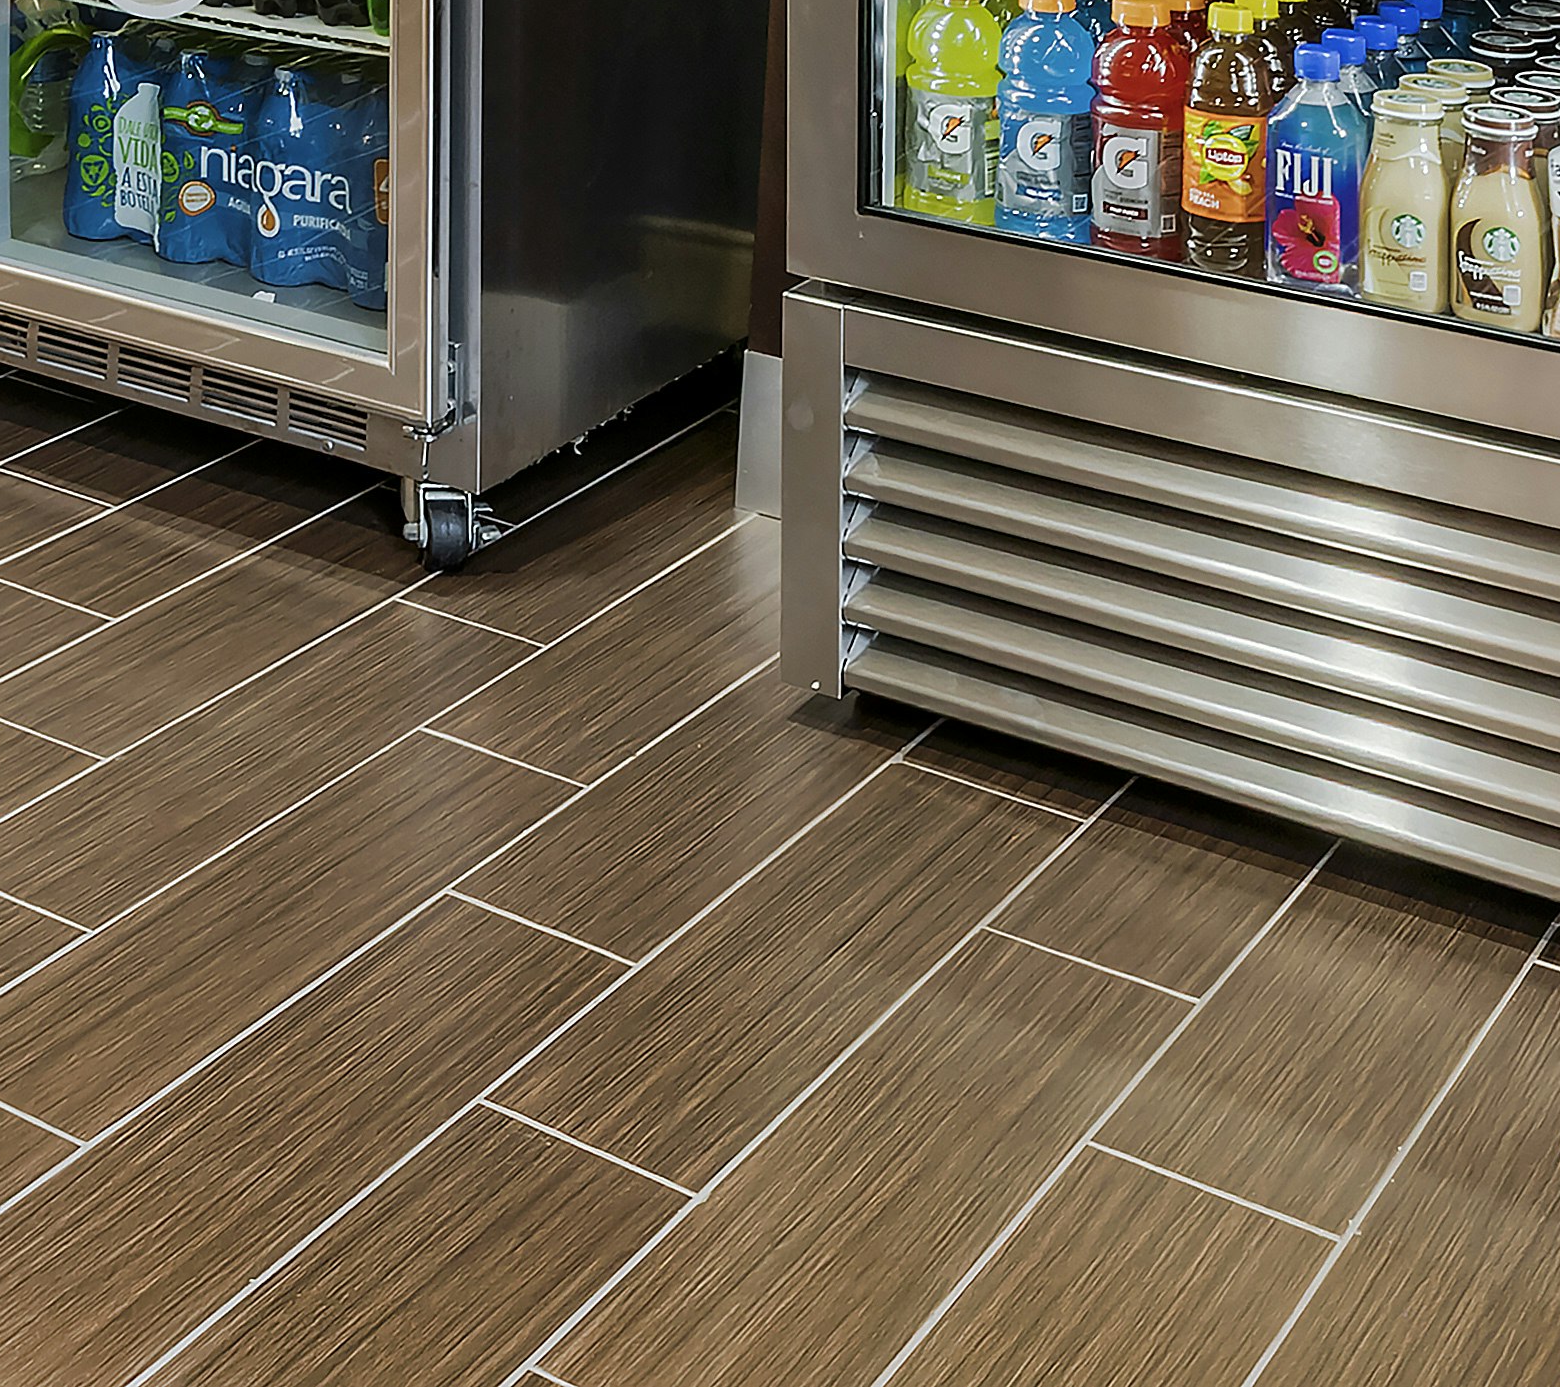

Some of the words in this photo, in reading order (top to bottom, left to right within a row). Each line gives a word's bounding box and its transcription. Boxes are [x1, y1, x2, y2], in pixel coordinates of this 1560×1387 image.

[930, 104, 972, 154] G
[1017, 121, 1061, 171] G
[118, 136, 159, 173] VIDA
[1103, 135, 1148, 189] G
[1208, 148, 1243, 166] Lipton
[1275, 149, 1333, 198] FIJI
[200, 144, 353, 216] niagara
